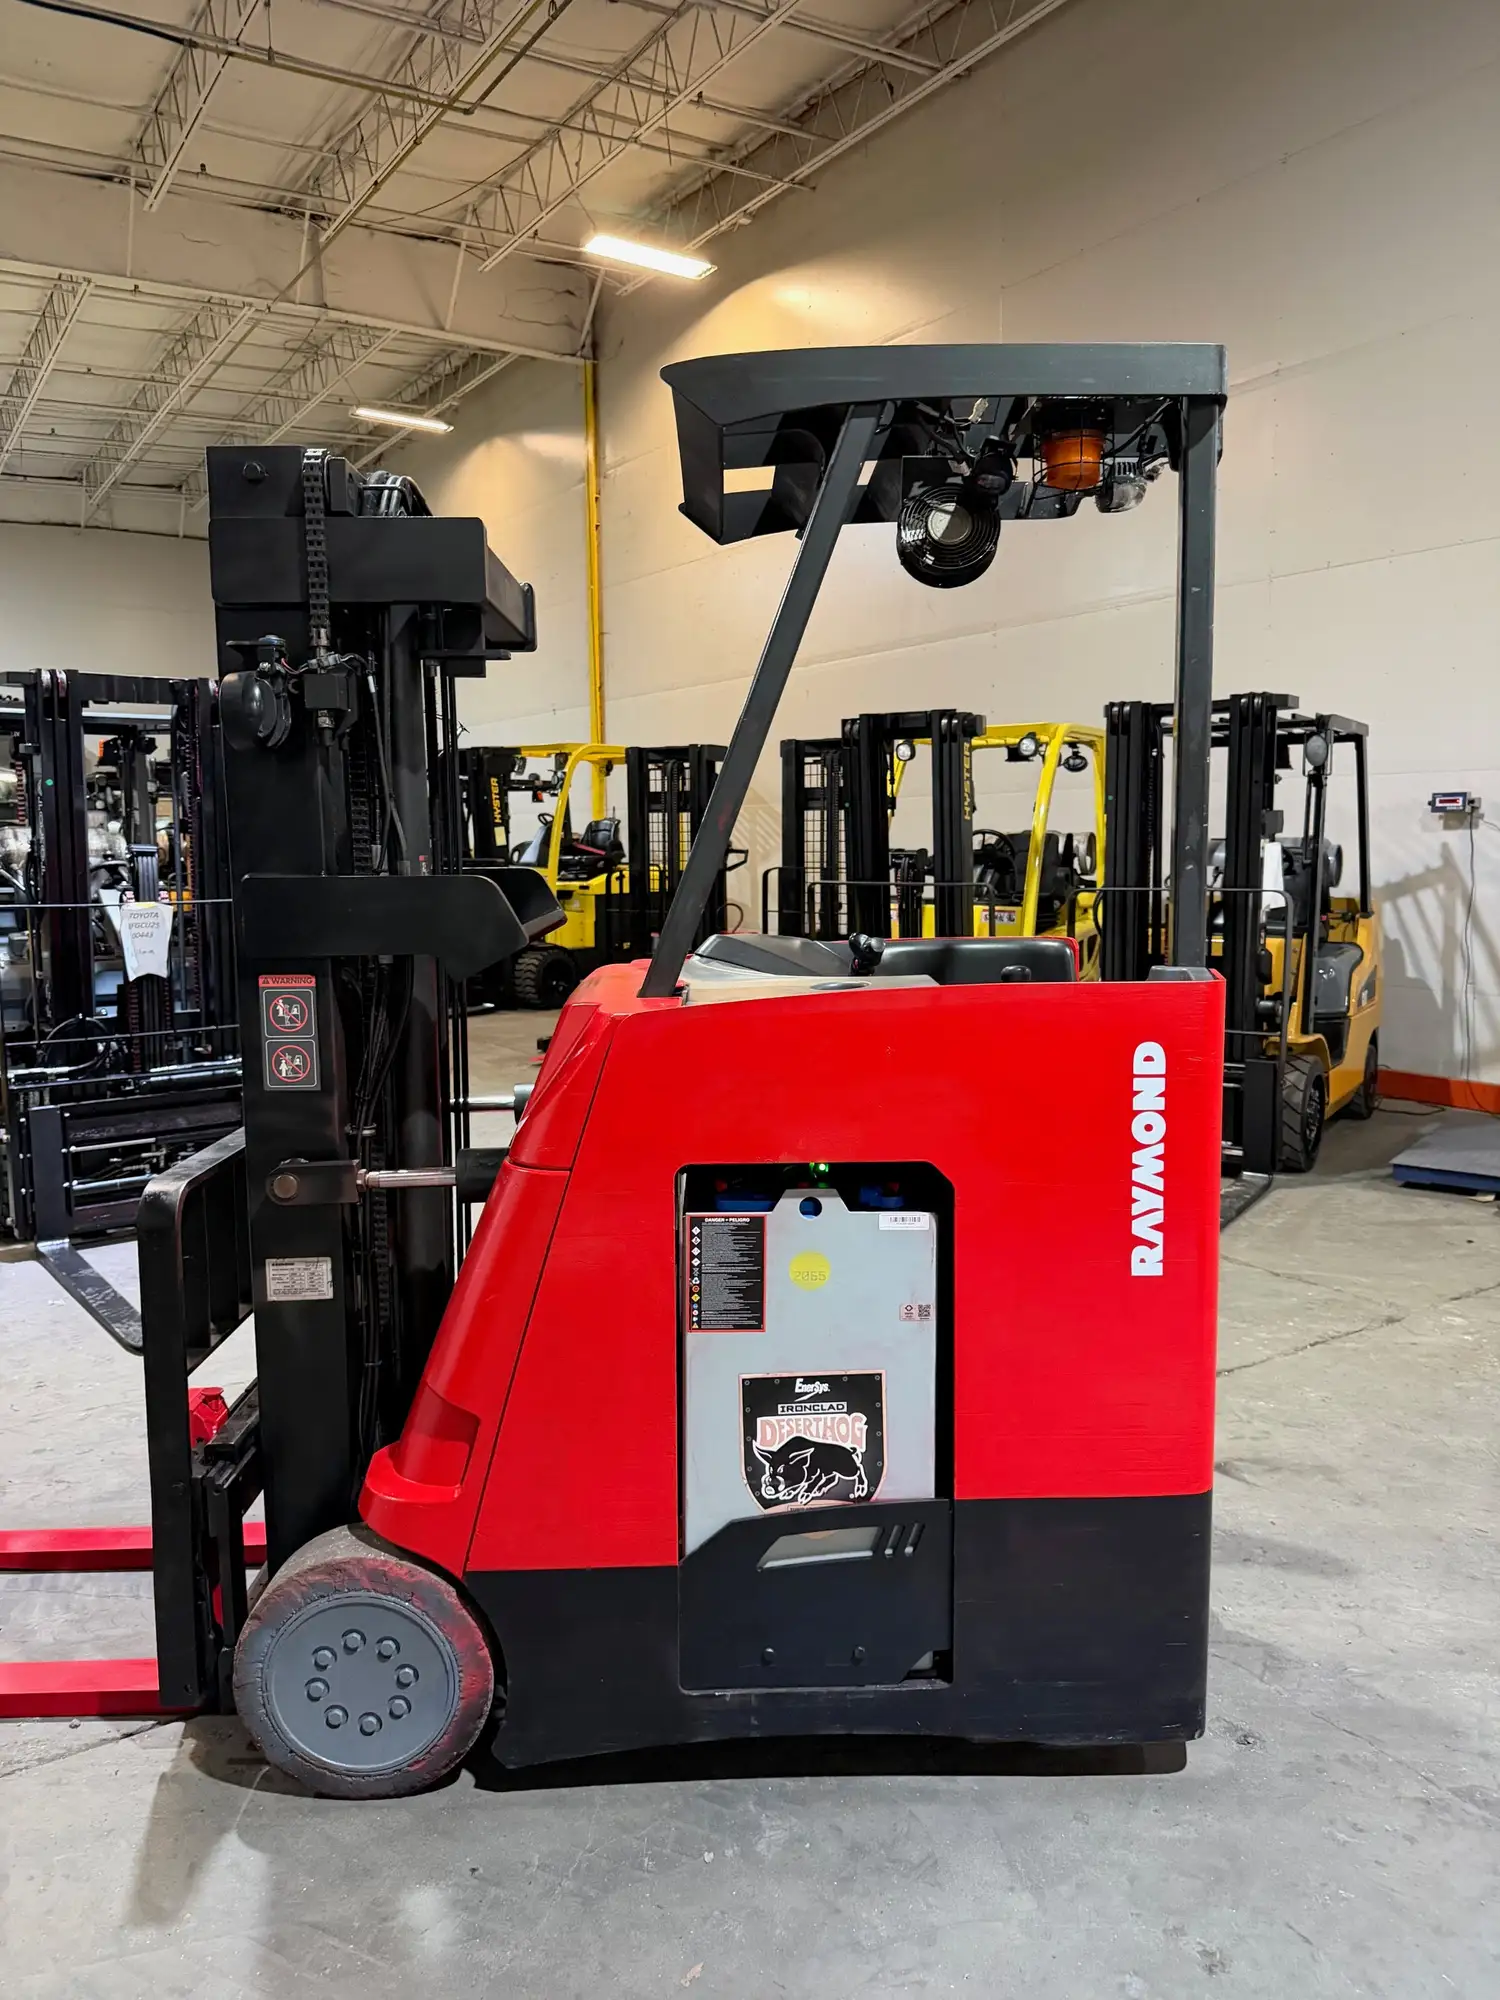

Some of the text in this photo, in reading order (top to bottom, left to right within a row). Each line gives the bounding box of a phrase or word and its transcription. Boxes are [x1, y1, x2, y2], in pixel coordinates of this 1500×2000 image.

[490, 777, 502, 823] HYSTER
[271, 976, 313, 985] WARNING
[1131, 1041, 1166, 1276] RAYMOND
[780, 1403, 845, 1413] IRONCLAD
[760, 1414, 864, 1448] DESERTHOG
